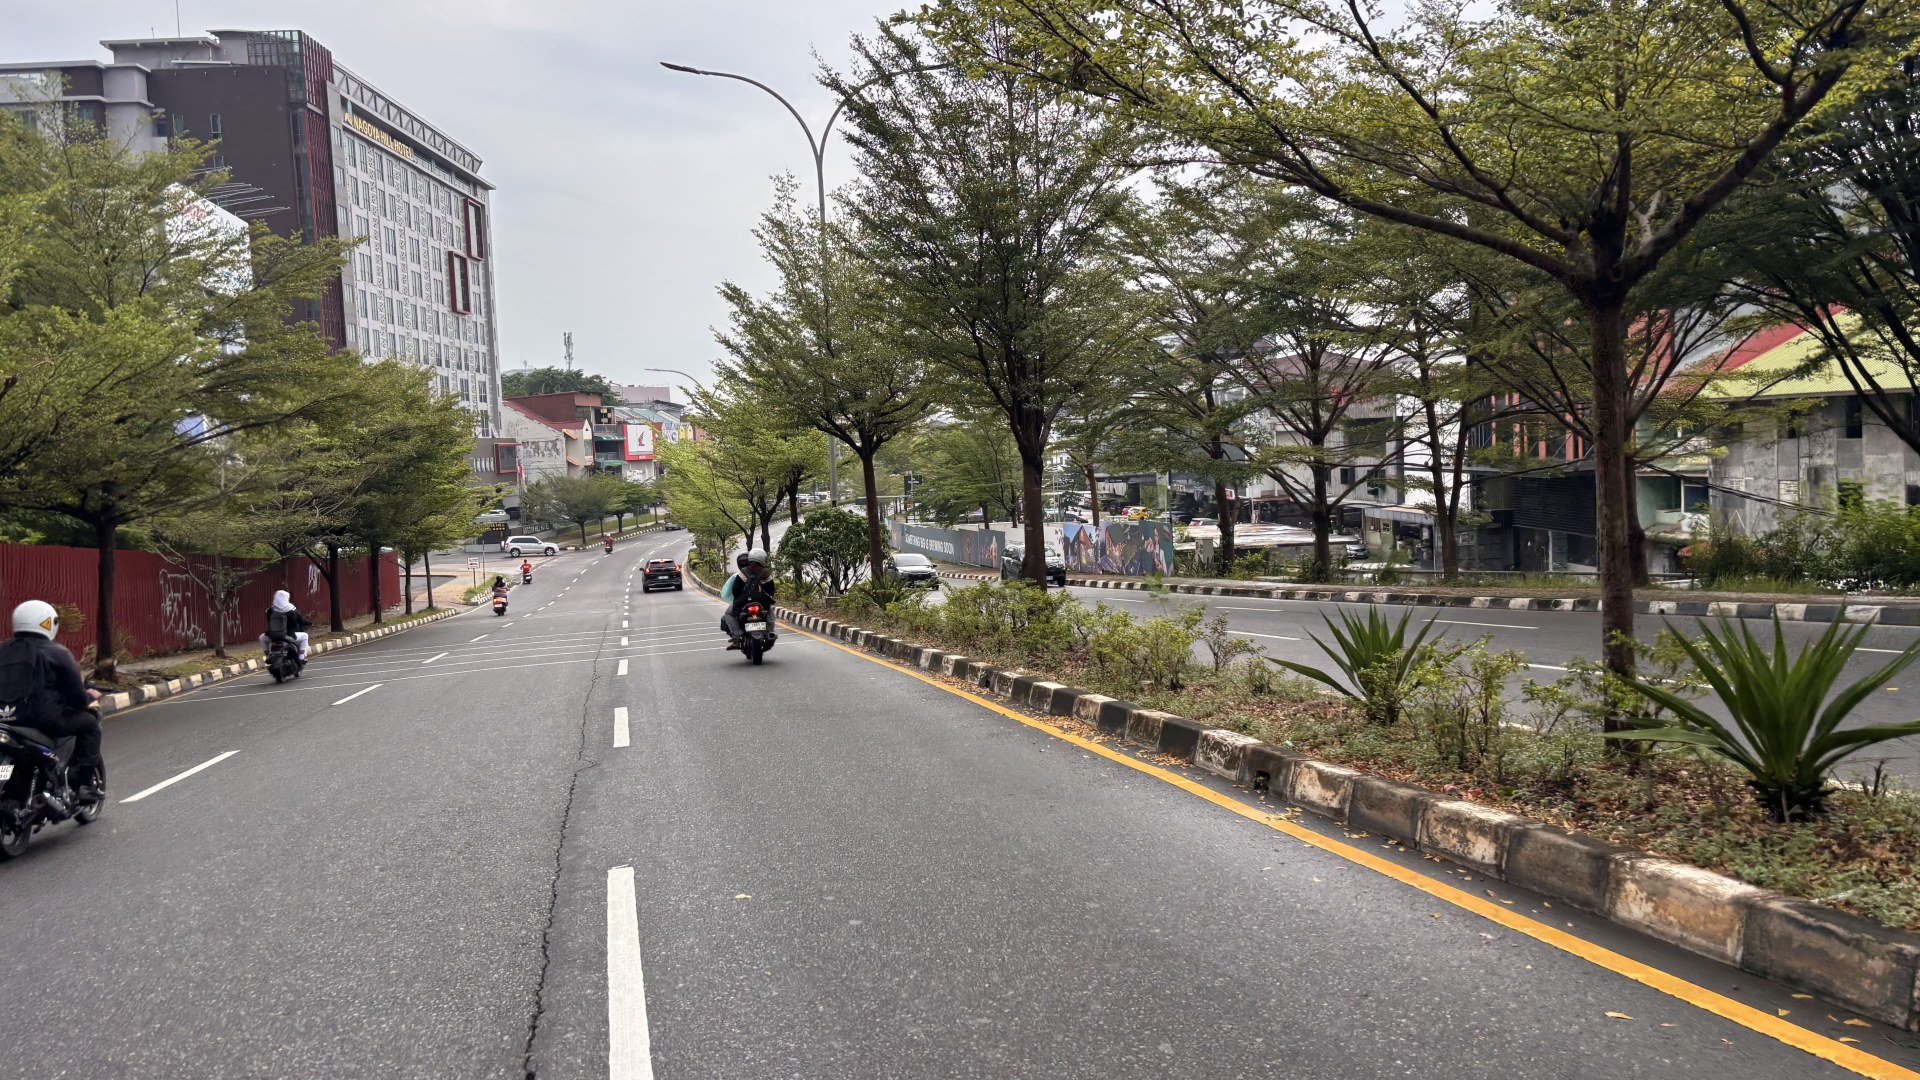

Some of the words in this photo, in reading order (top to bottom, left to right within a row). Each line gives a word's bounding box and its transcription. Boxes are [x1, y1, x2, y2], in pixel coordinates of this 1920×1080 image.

[353, 114, 381, 142] NAGOYA
[380, 130, 394, 150] HILL
[394, 138, 414, 160] HOTEL
